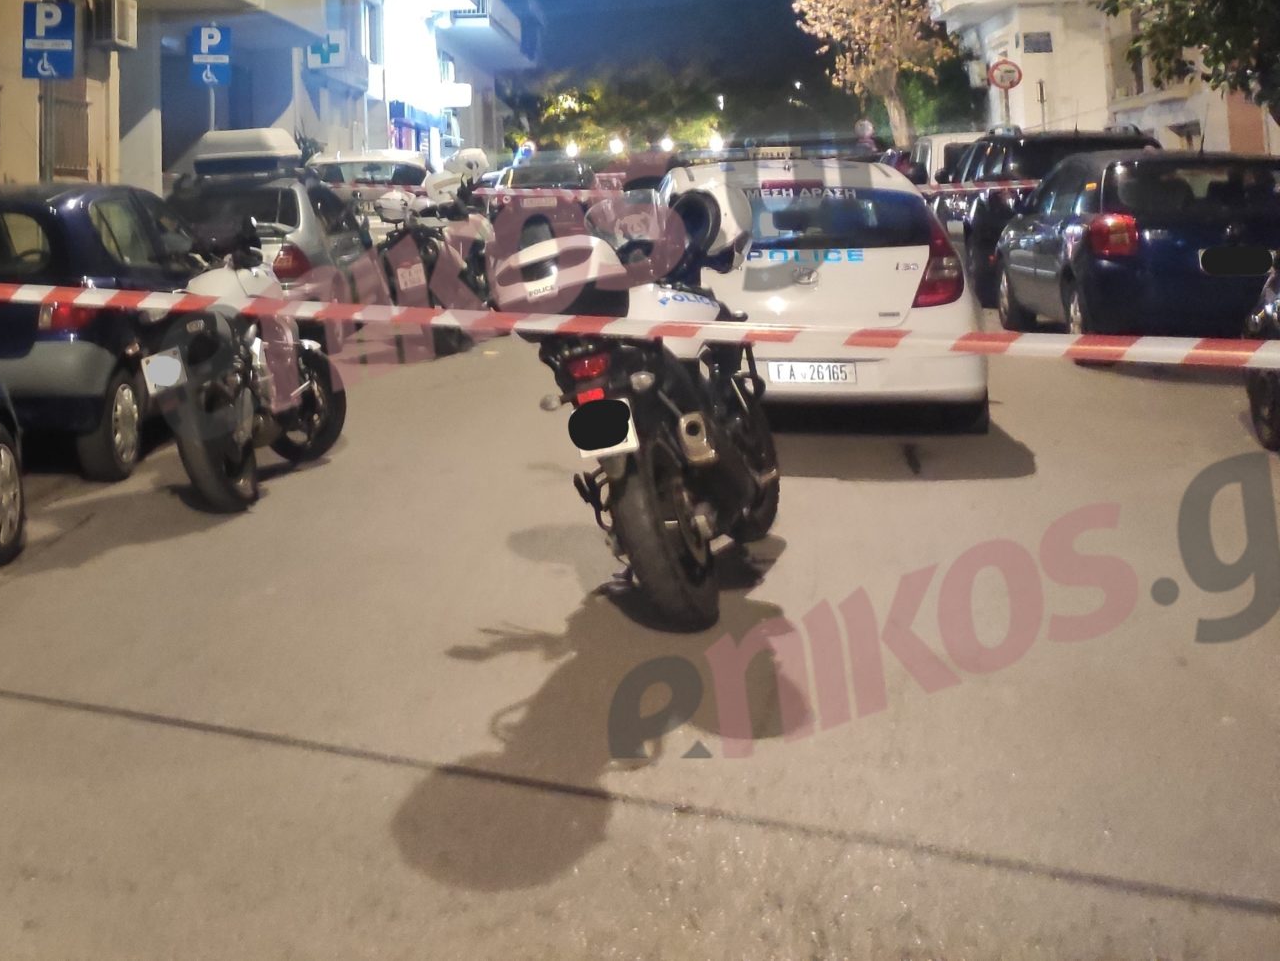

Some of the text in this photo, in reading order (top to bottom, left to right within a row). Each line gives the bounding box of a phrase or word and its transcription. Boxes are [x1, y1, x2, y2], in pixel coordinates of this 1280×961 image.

[35, 2, 62, 37] P
[201, 27, 221, 54] P
[746, 187, 857, 199] ΜΕΣΗ ΔΡΑΣΗ
[746, 248, 864, 263] POLICE
[809, 363, 848, 381] 26165
